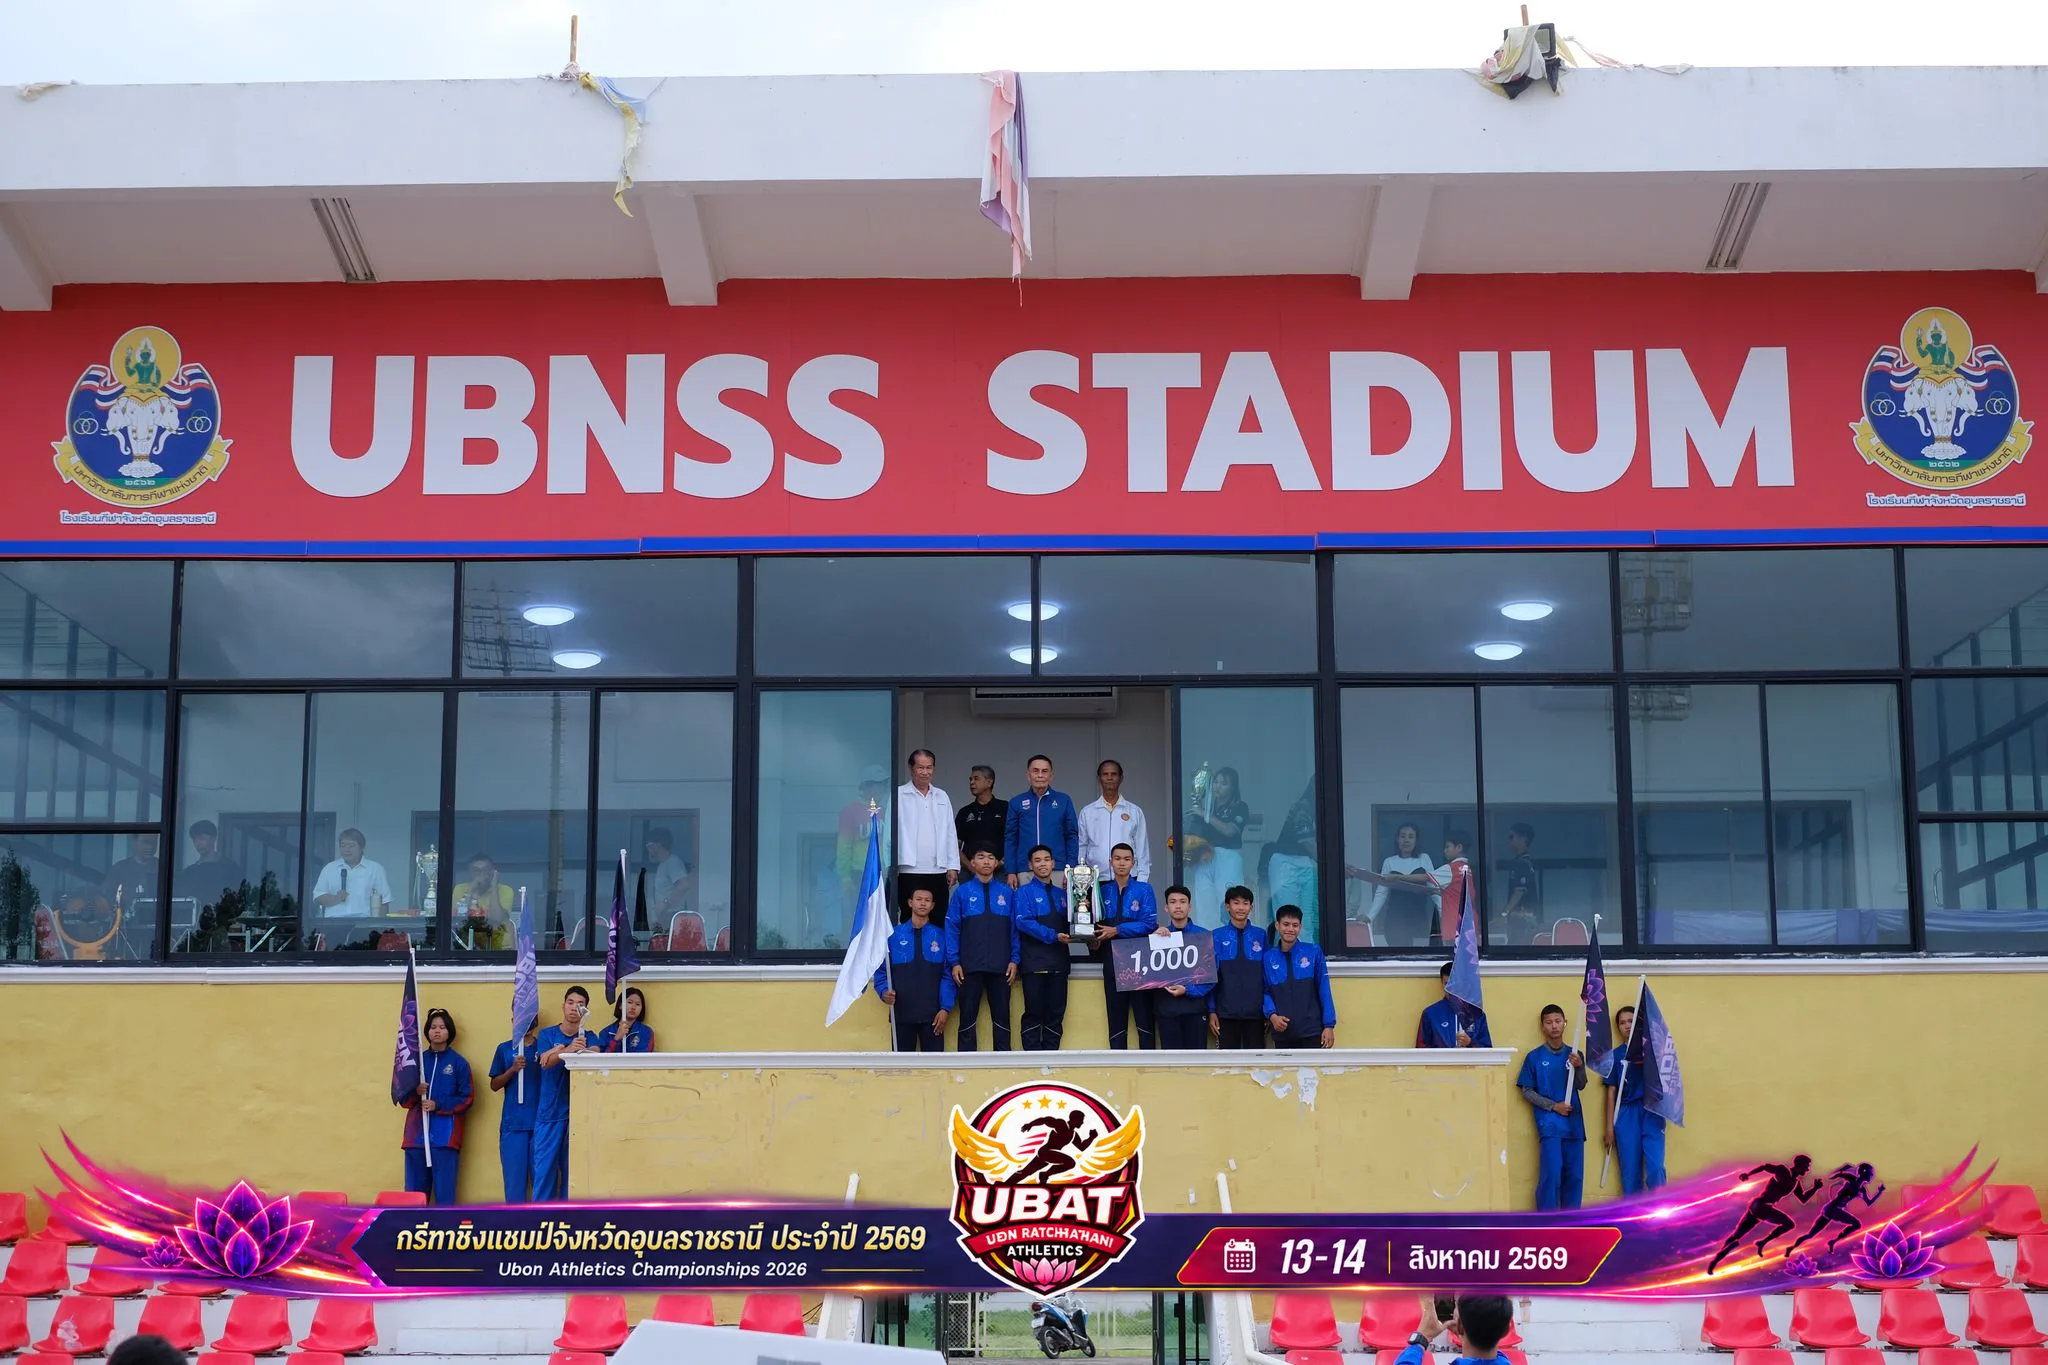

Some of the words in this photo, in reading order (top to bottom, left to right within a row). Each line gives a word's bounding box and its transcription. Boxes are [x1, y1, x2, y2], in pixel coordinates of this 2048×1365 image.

[291, 353, 885, 499] UBNSS
[987, 346, 1796, 494] STADIUM
[1875, 446, 2013, 484] มหาวิทยาลัยการกีฬาแห่งชาติ
[73, 464, 209, 502] มหาวิทยาลัยการกีฬาแห่งชาติ
[61, 511, 216, 526] โรงเรียนกีฬาจังหวัดอุบลราชธานี
[1867, 494, 2025, 508] โรงเรียนกีฬาจังหวัดอุบลราชธานี
[1130, 944, 1199, 976] 1,000
